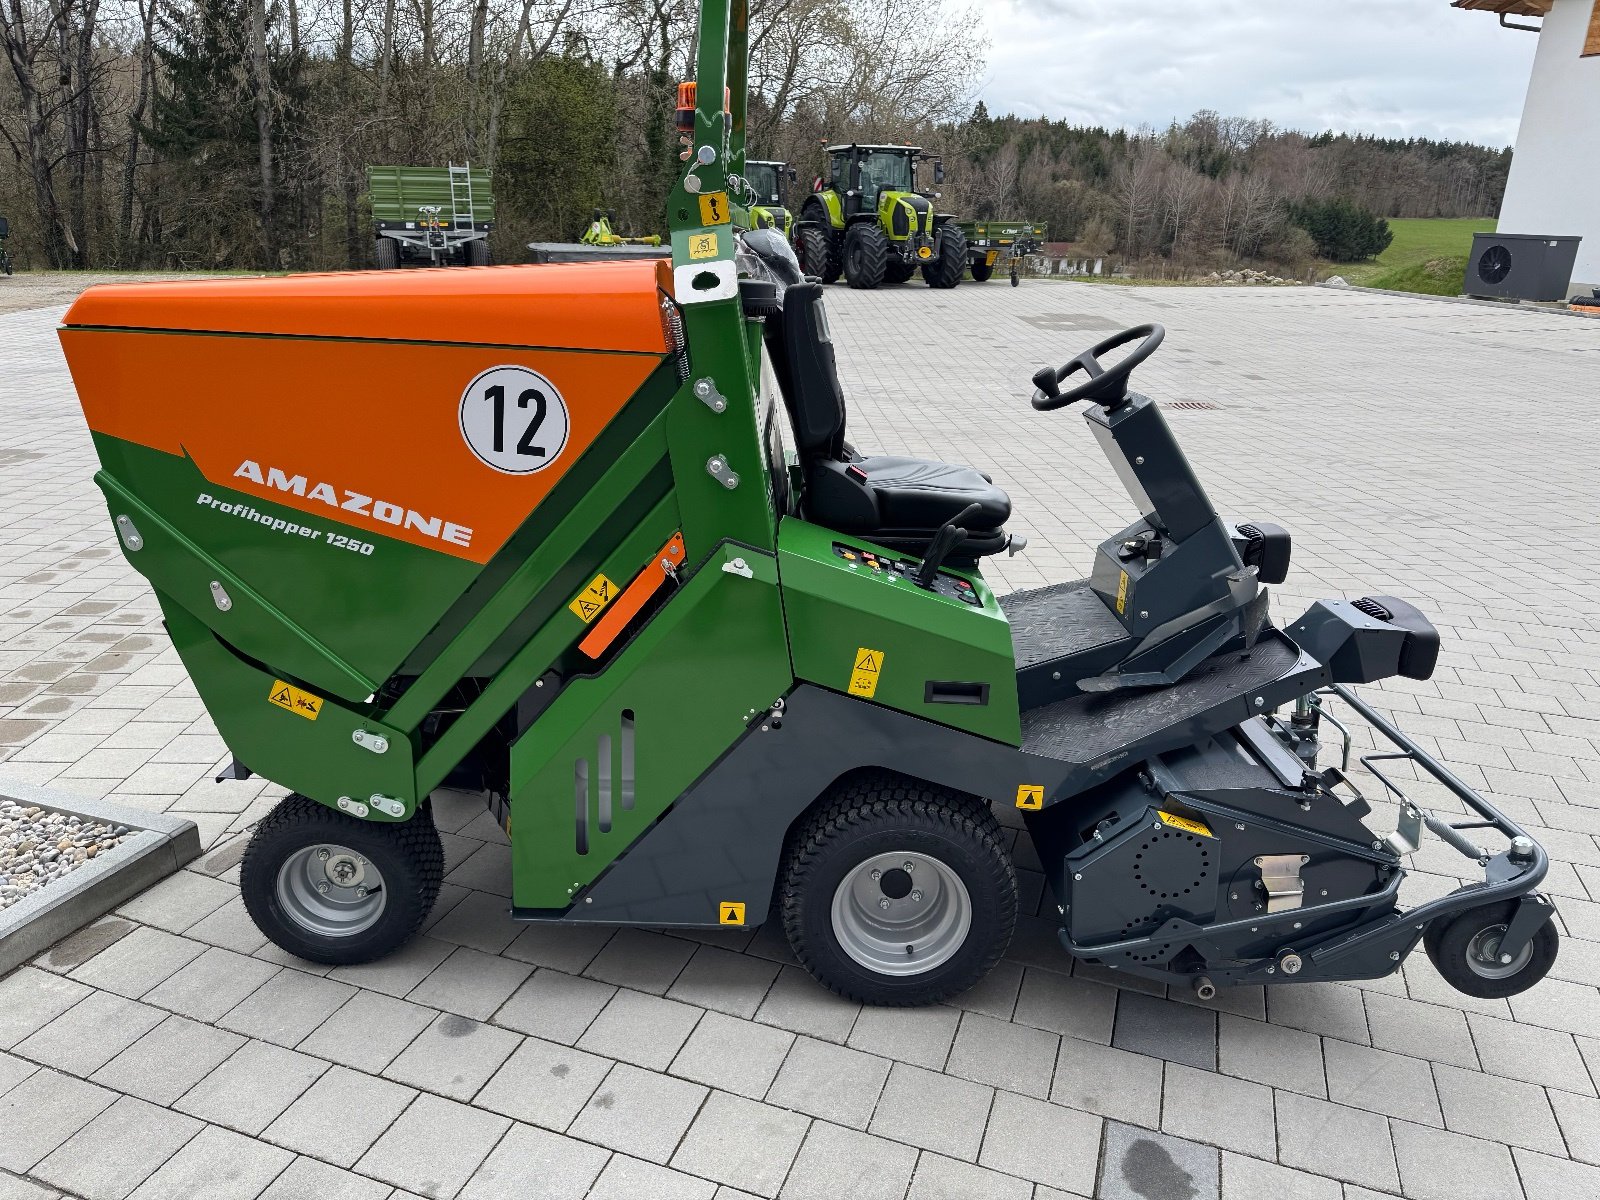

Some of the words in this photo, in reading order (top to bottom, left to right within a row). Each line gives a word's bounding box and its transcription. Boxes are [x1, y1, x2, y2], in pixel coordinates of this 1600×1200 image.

[485, 385, 546, 457] 12
[196, 493, 321, 543] Profihopper
[327, 533, 376, 556] 1250
[234, 460, 474, 548] AMAZONE
